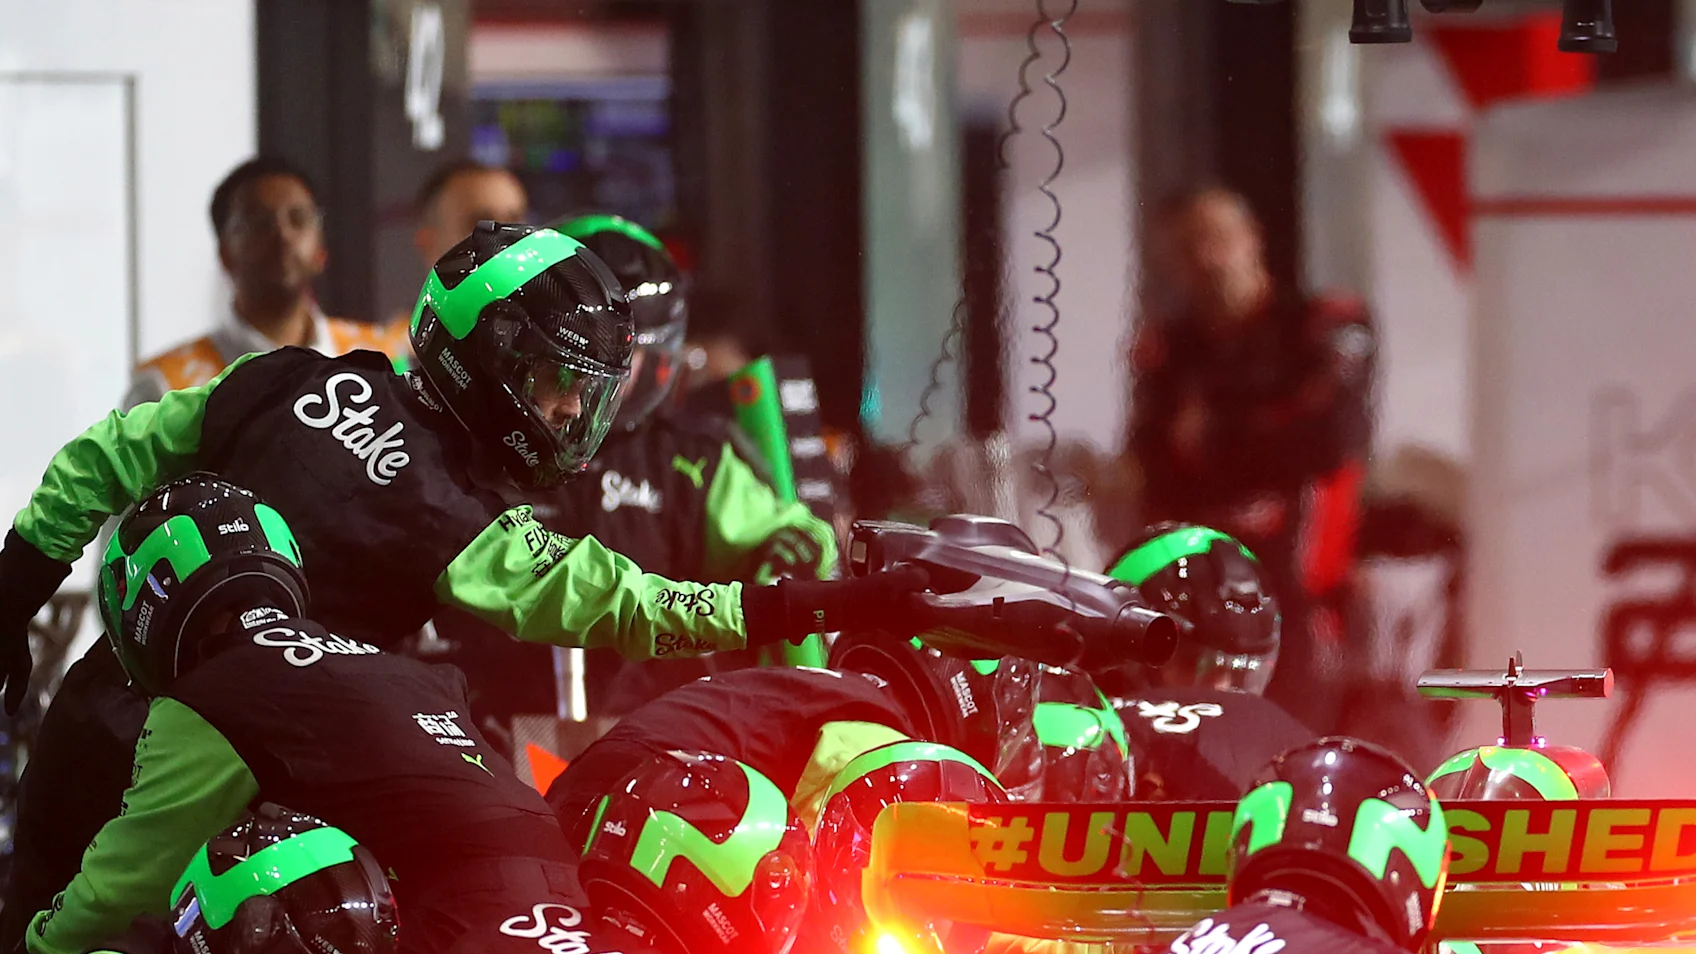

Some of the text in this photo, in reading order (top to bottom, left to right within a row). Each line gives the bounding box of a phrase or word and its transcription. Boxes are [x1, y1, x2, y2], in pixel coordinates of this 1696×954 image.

[437, 353, 469, 391] WORKWEAR
[441, 346, 473, 385] MASCOT
[293, 371, 411, 487] Stake
[503, 430, 540, 467] Stake
[218, 518, 250, 536] Stilo
[655, 588, 716, 617] Stake
[133, 601, 150, 644] MASCOT
[253, 627, 381, 667] Stake
[955, 671, 979, 715] MASCOT
[707, 902, 740, 939] MASCOT
